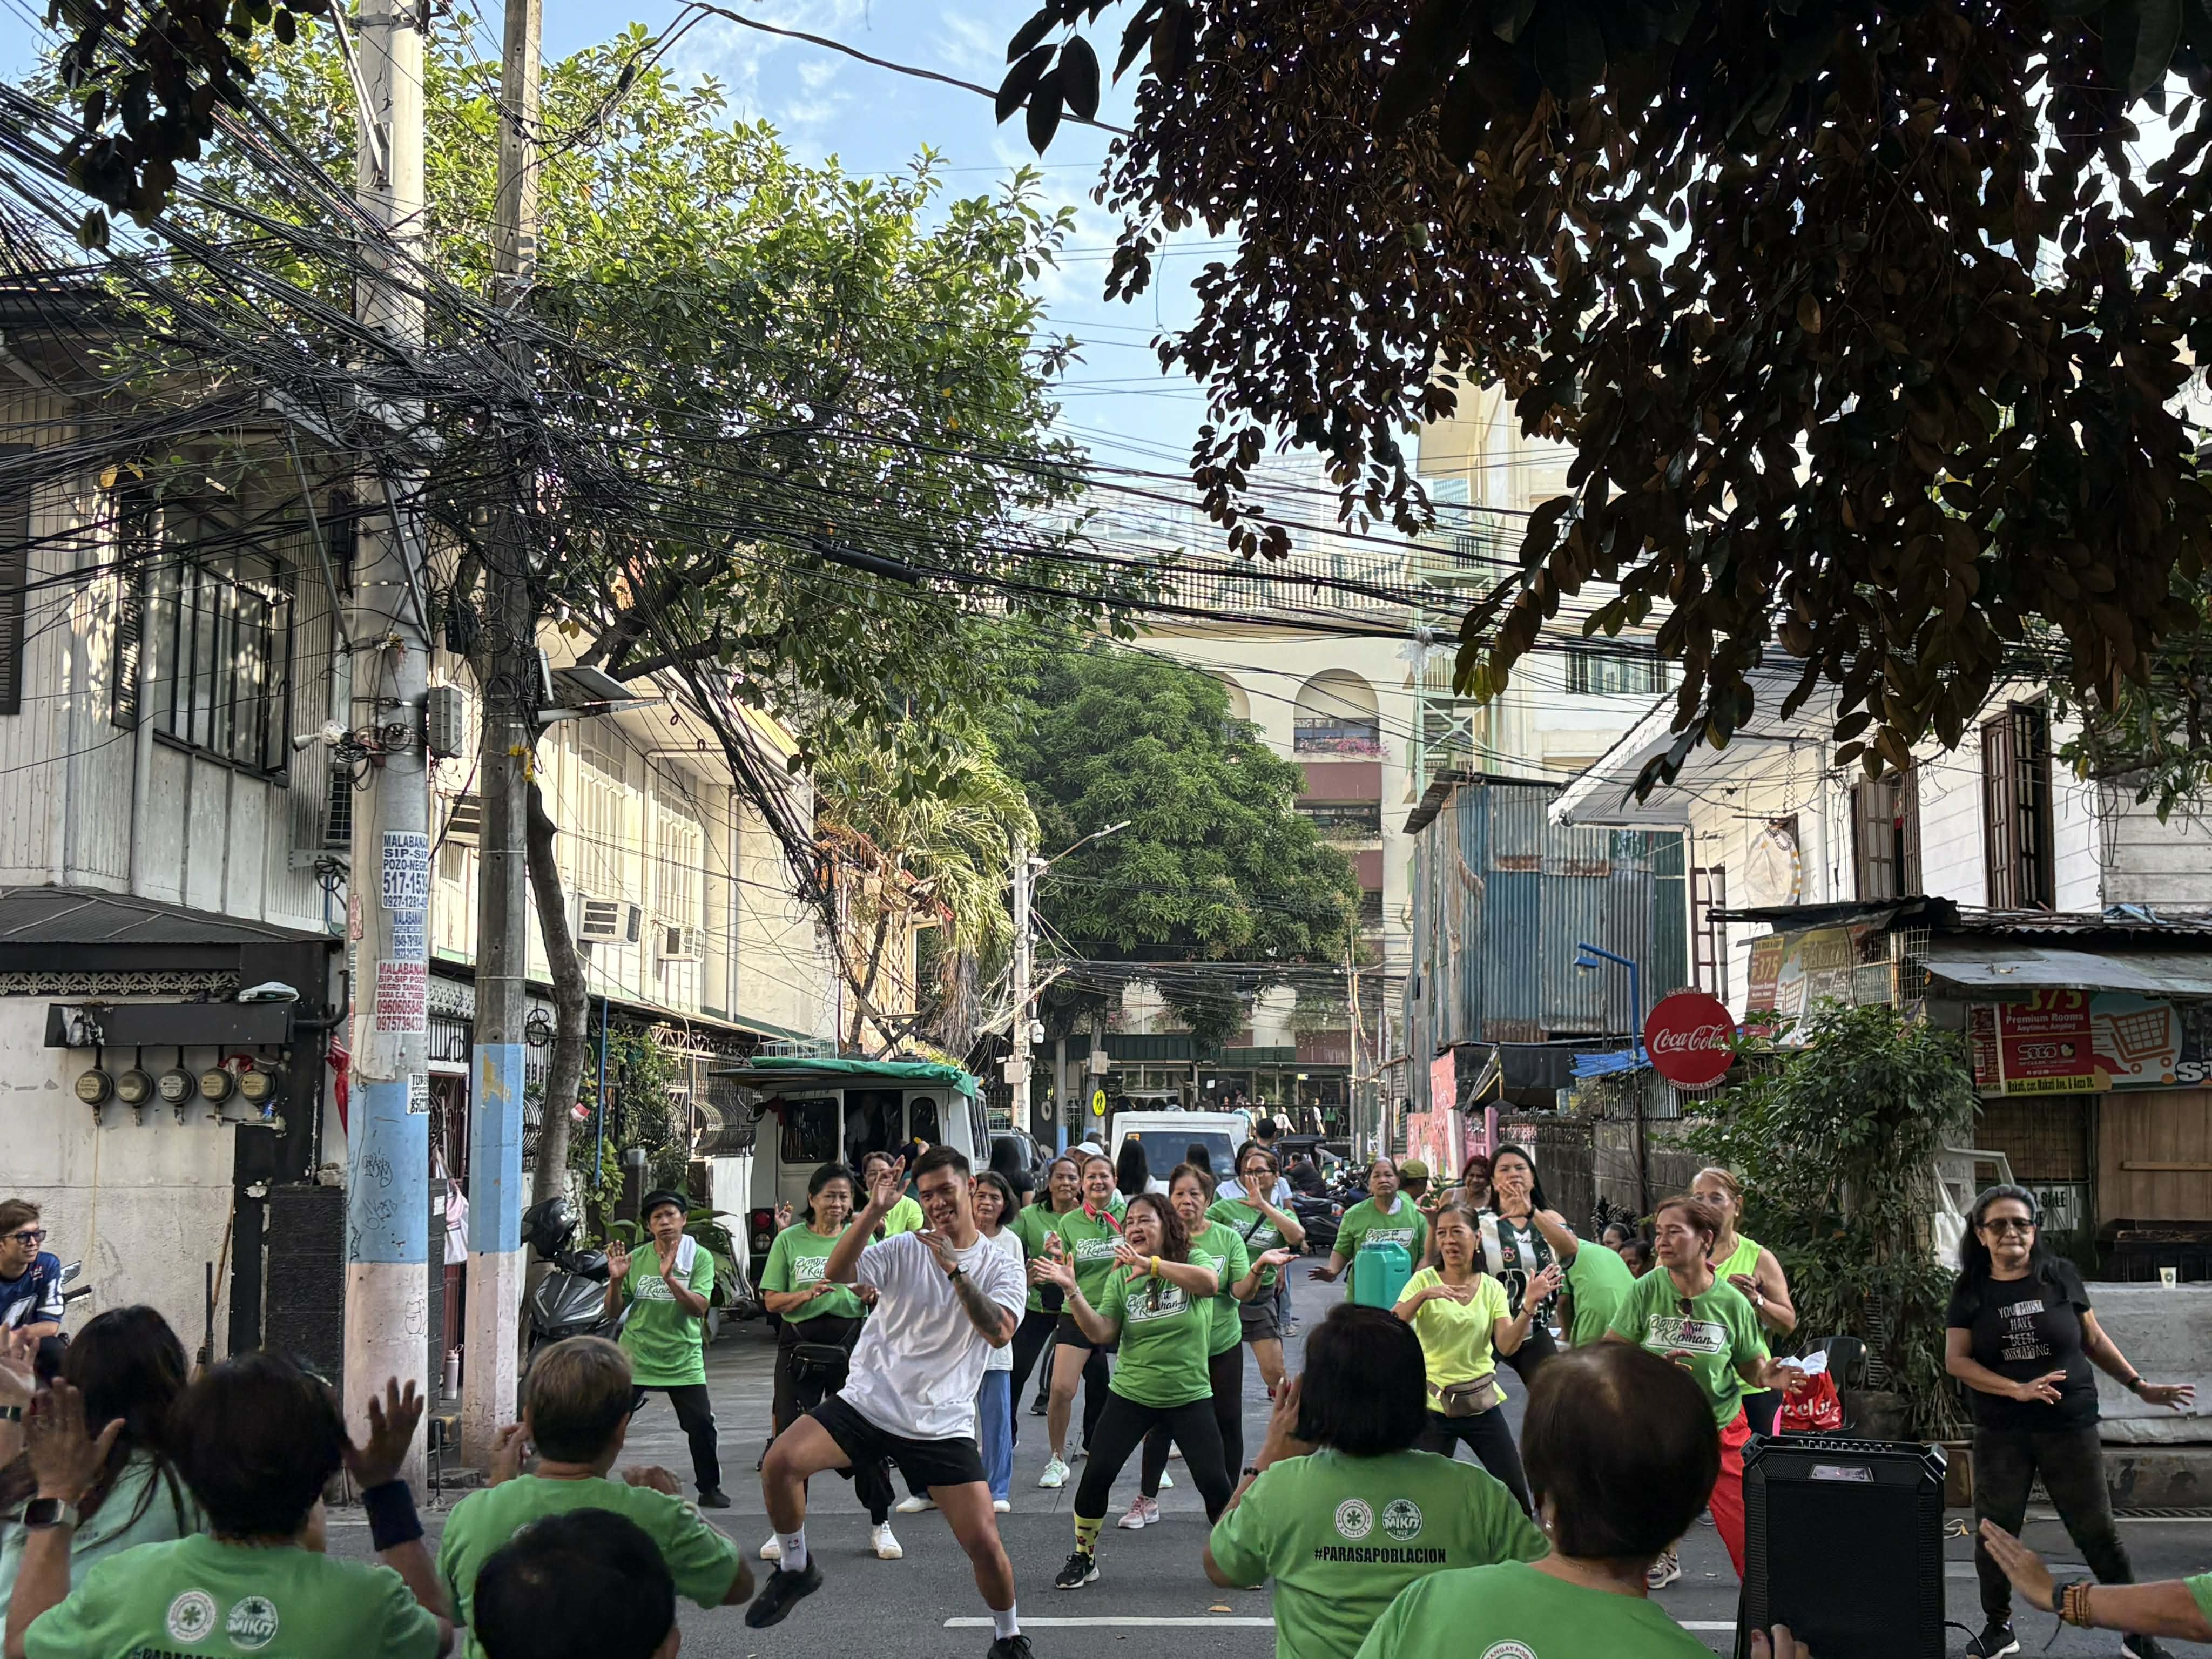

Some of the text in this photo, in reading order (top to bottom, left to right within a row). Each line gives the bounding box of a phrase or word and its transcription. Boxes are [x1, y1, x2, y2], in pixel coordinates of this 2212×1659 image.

[2006, 1016, 2048, 1024] Premium
[1998, 1300, 2044, 1318] YOU MUST
[2009, 1316, 2035, 1331] HAVE
[1314, 1546, 1447, 1563] #PARASAPOBLACION
